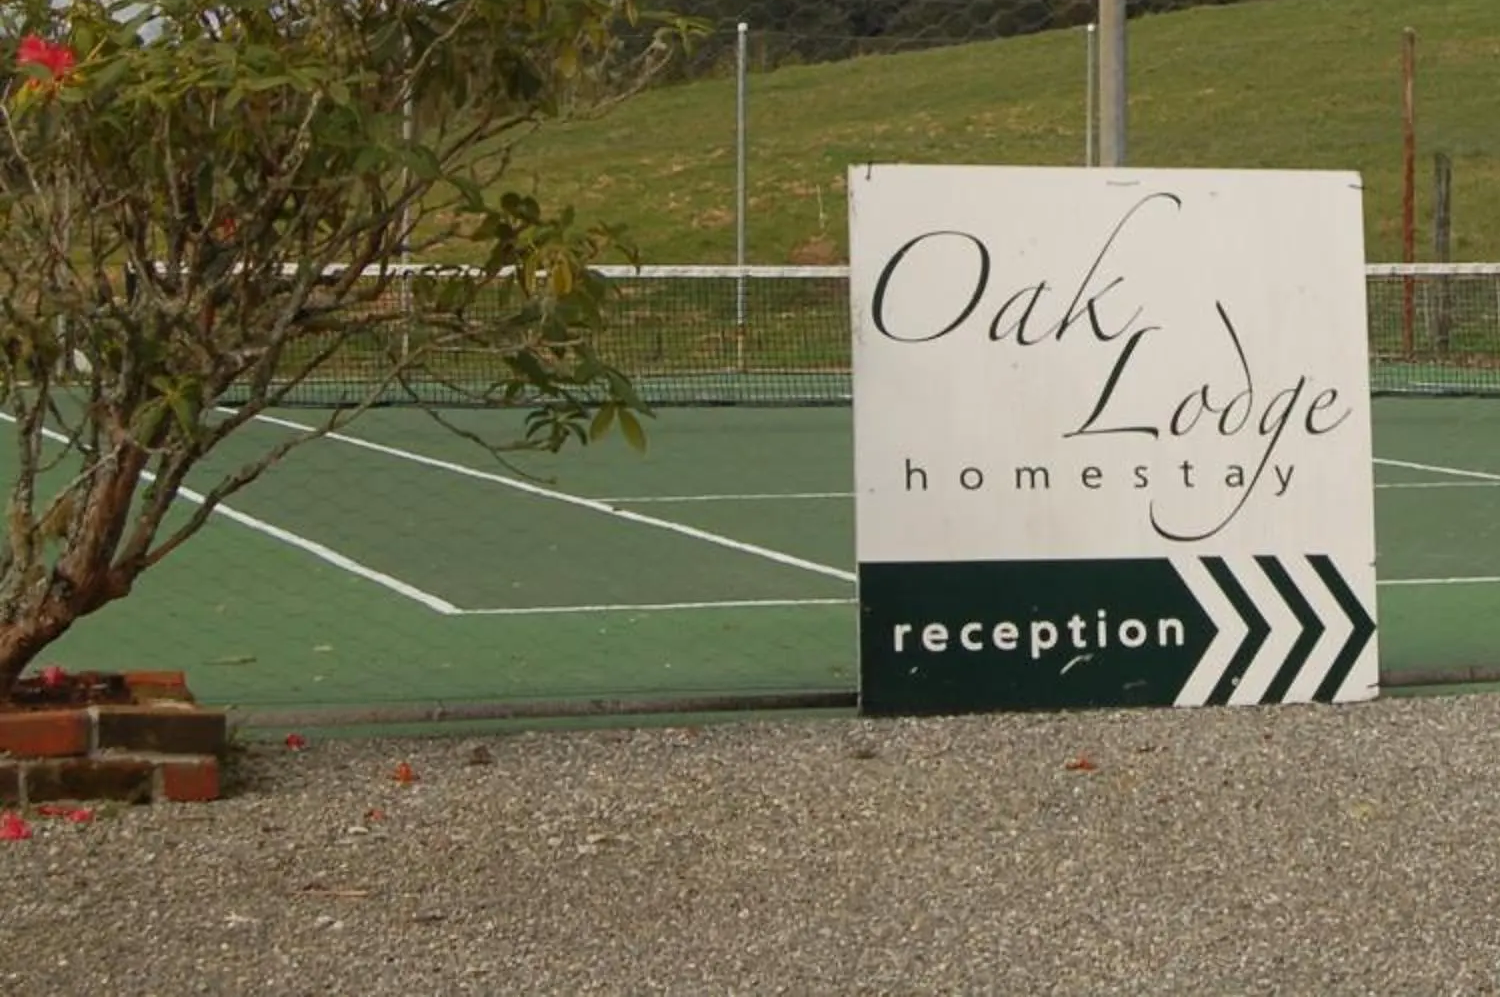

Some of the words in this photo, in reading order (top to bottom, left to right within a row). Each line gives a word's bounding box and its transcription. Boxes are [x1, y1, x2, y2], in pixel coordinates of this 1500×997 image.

[871, 192, 1182, 346] Oak
[1062, 300, 1353, 542] Lodge
[904, 459, 1295, 495] homestay
[893, 609, 1185, 659] reception
